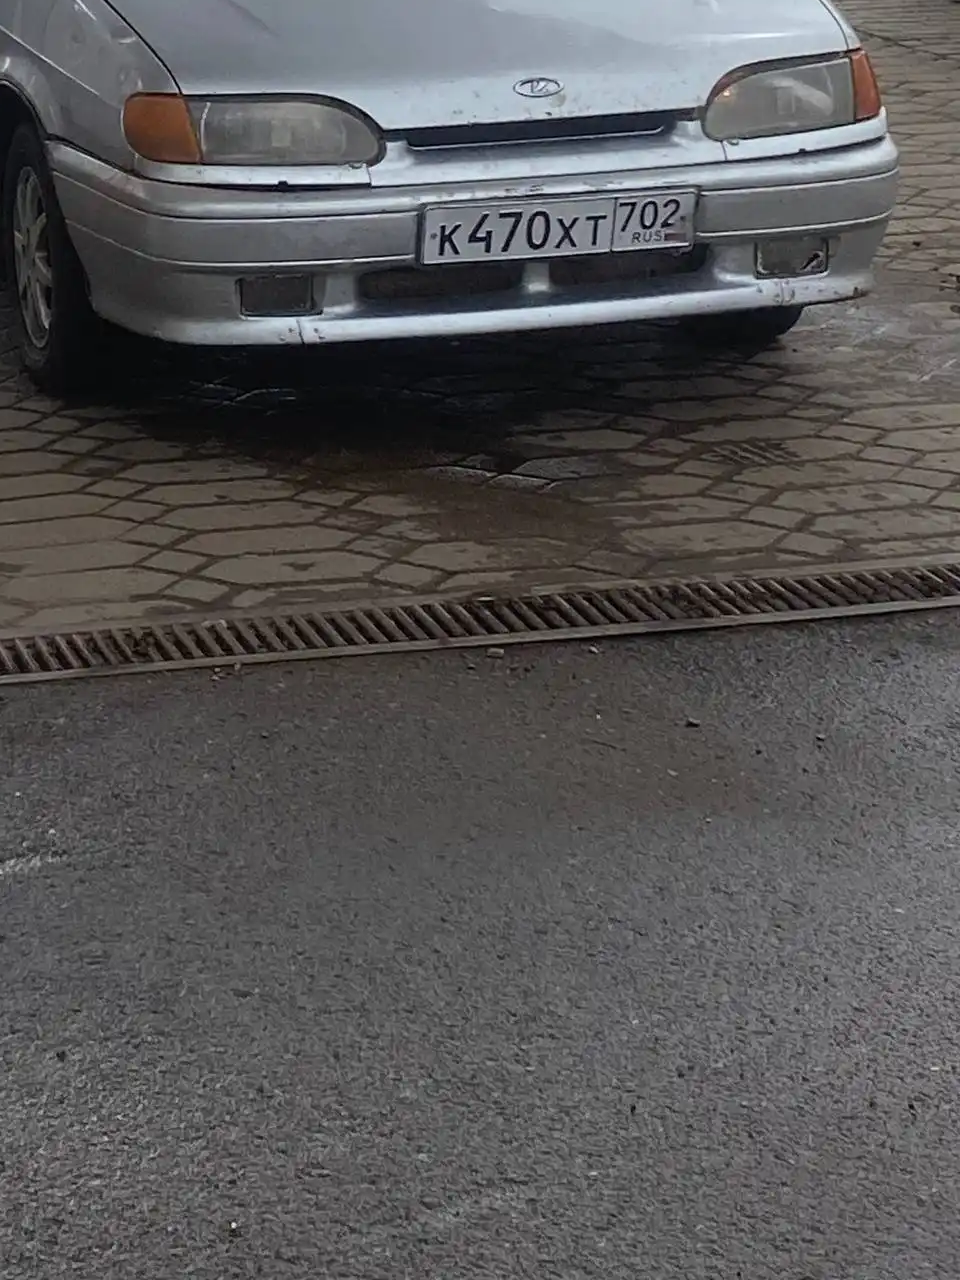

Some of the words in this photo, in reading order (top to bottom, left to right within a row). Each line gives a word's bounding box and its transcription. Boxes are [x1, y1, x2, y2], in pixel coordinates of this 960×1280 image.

[438, 210, 607, 256] К470ХТ
[618, 198, 681, 233] 702
[631, 231, 664, 243] RUS
